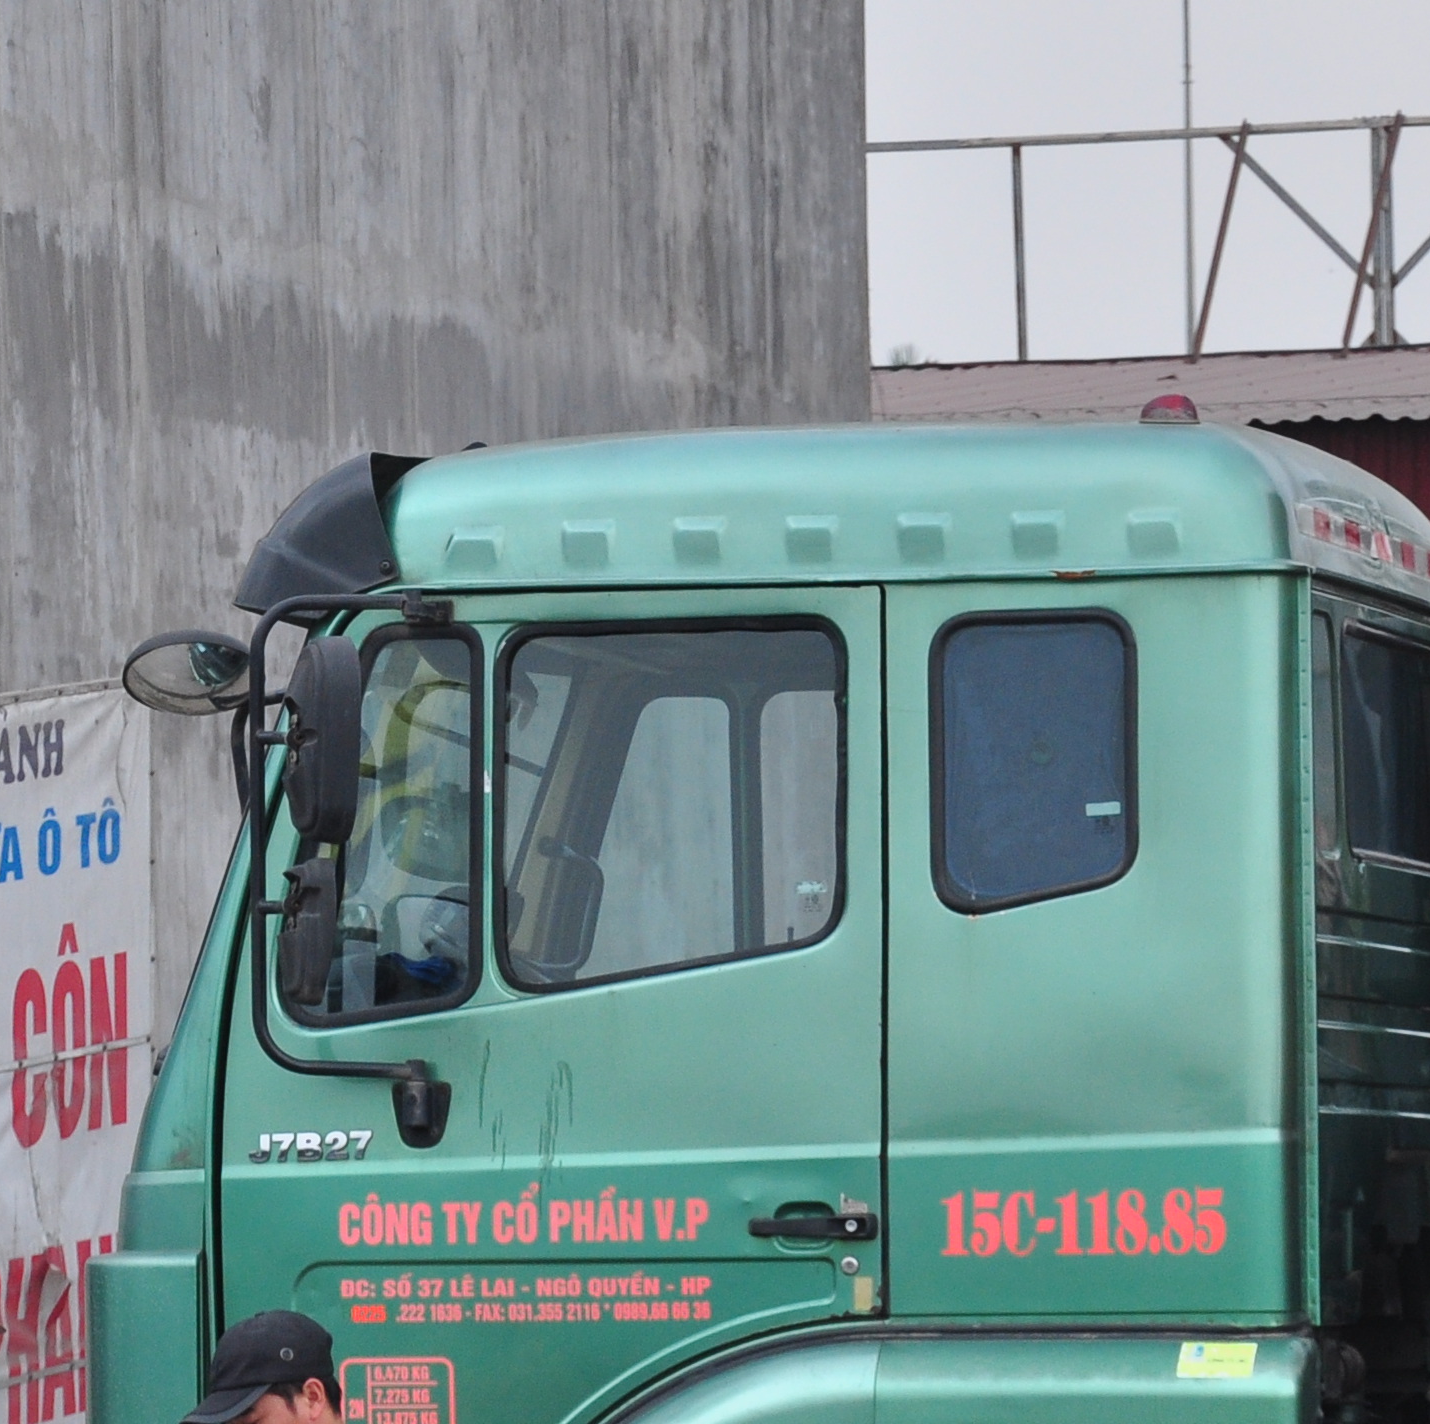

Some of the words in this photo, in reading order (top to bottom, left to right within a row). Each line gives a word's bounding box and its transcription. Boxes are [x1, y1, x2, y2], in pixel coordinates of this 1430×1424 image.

[37, 807, 62, 877] Ô
[75, 796, 122, 869] TÔ
[11, 922, 129, 1150] CÔN
[248, 1129, 373, 1164] J7B27
[338, 1191, 433, 1245] CÔNG
[441, 1202, 482, 1245] TY
[492, 1181, 540, 1245] CỔ
[653, 1198, 710, 1242] V.P
[939, 1186, 1228, 1258] 15C-118.85
[417, 1278, 444, 1298] 37
[450, 1272, 475, 1298] LÊ
[480, 1278, 515, 1298] LAI
[680, 1276, 712, 1297] HP
[474, 1302, 506, 1322] FAX:
[411, 1365, 430, 1380] KG
[412, 1388, 431, 1403] KG
